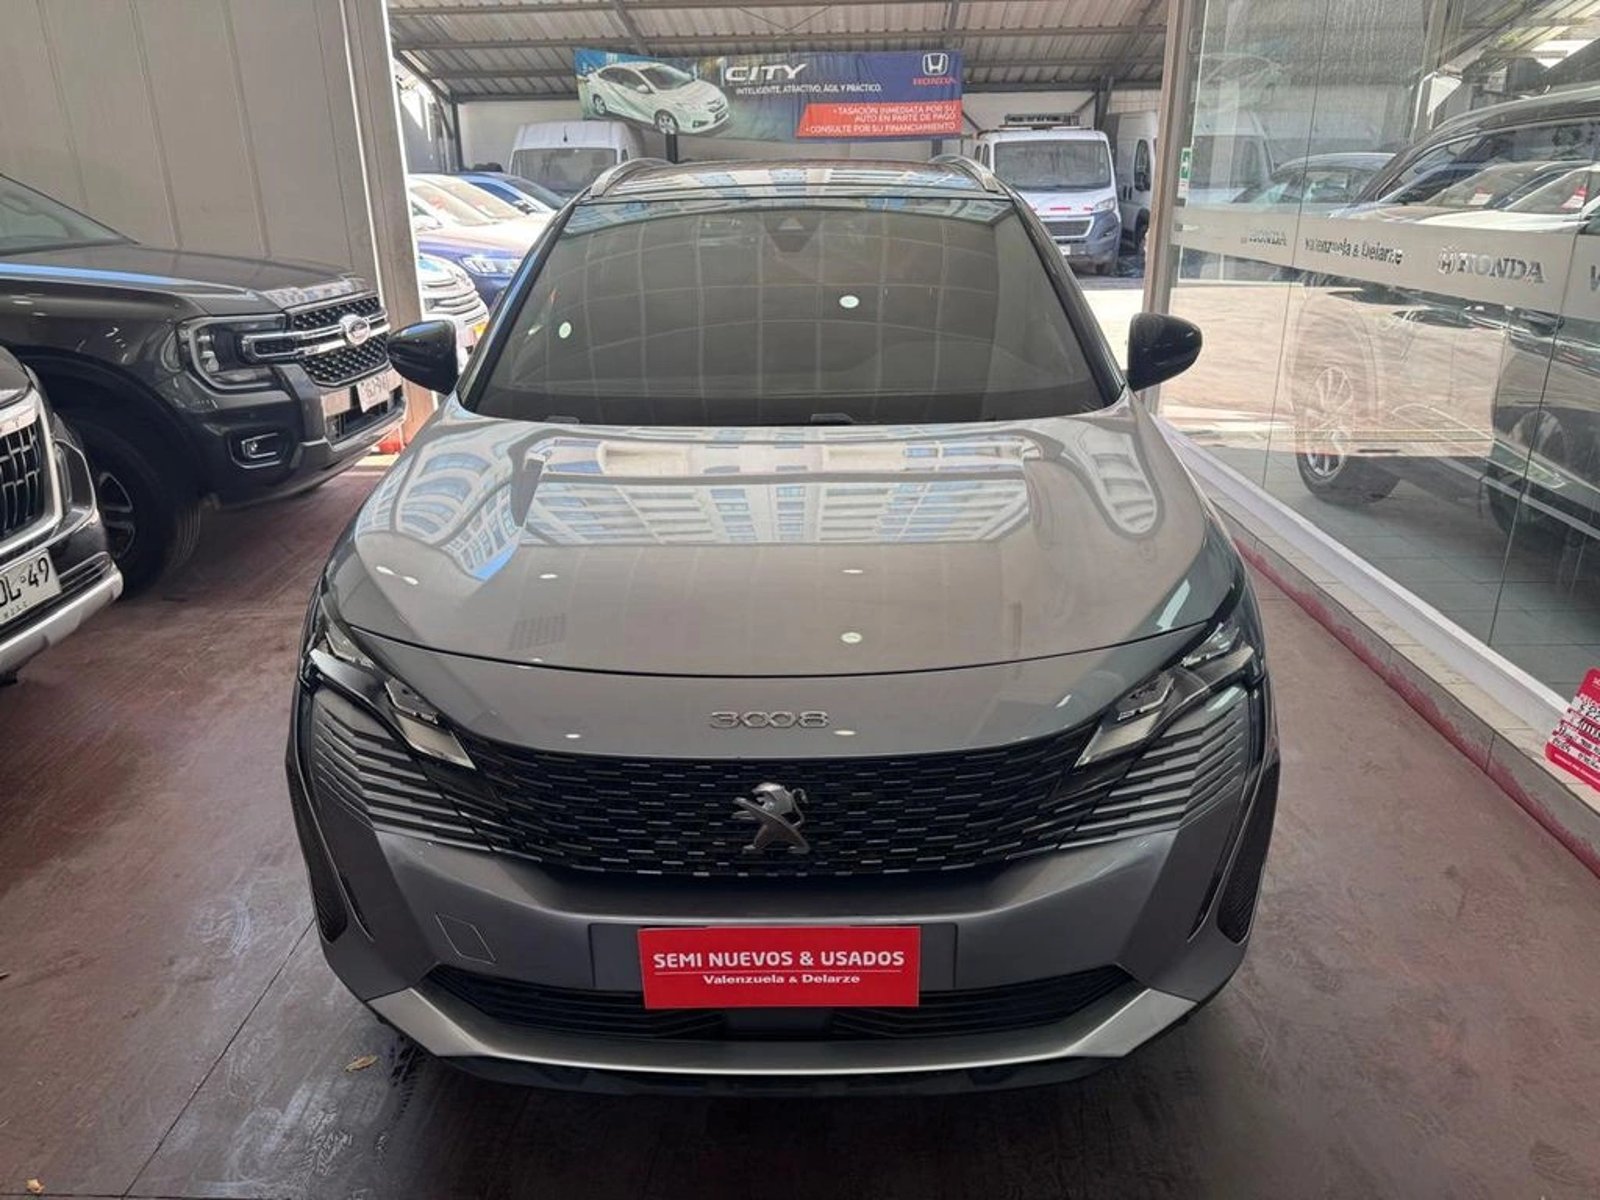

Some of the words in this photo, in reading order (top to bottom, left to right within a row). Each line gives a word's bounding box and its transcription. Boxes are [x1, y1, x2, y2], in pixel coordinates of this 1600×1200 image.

[725, 63, 808, 81] CITY
[912, 77, 957, 87] HONDA
[926, 105, 941, 113] POR
[944, 105, 956, 113] SU
[855, 114, 876, 122] AUTO
[879, 114, 889, 122] EN
[891, 114, 917, 122] PARTE
[920, 113, 931, 121] DE
[811, 125, 851, 134] CONSULTE
[854, 124, 870, 132] POR
[872, 124, 883, 132] SU
[885, 122, 955, 132] FINANCIAMIENTO
[1457, 252, 1545, 284] HONDA
[711, 710, 829, 729] 3008
[653, 952, 702, 969] SEMI
[708, 951, 793, 967] NUEVOS
[799, 951, 815, 966] &
[820, 951, 905, 966] USADOS
[703, 974, 785, 984] Valenzuela
[789, 976, 798, 984] &
[802, 974, 860, 984] Delarze
